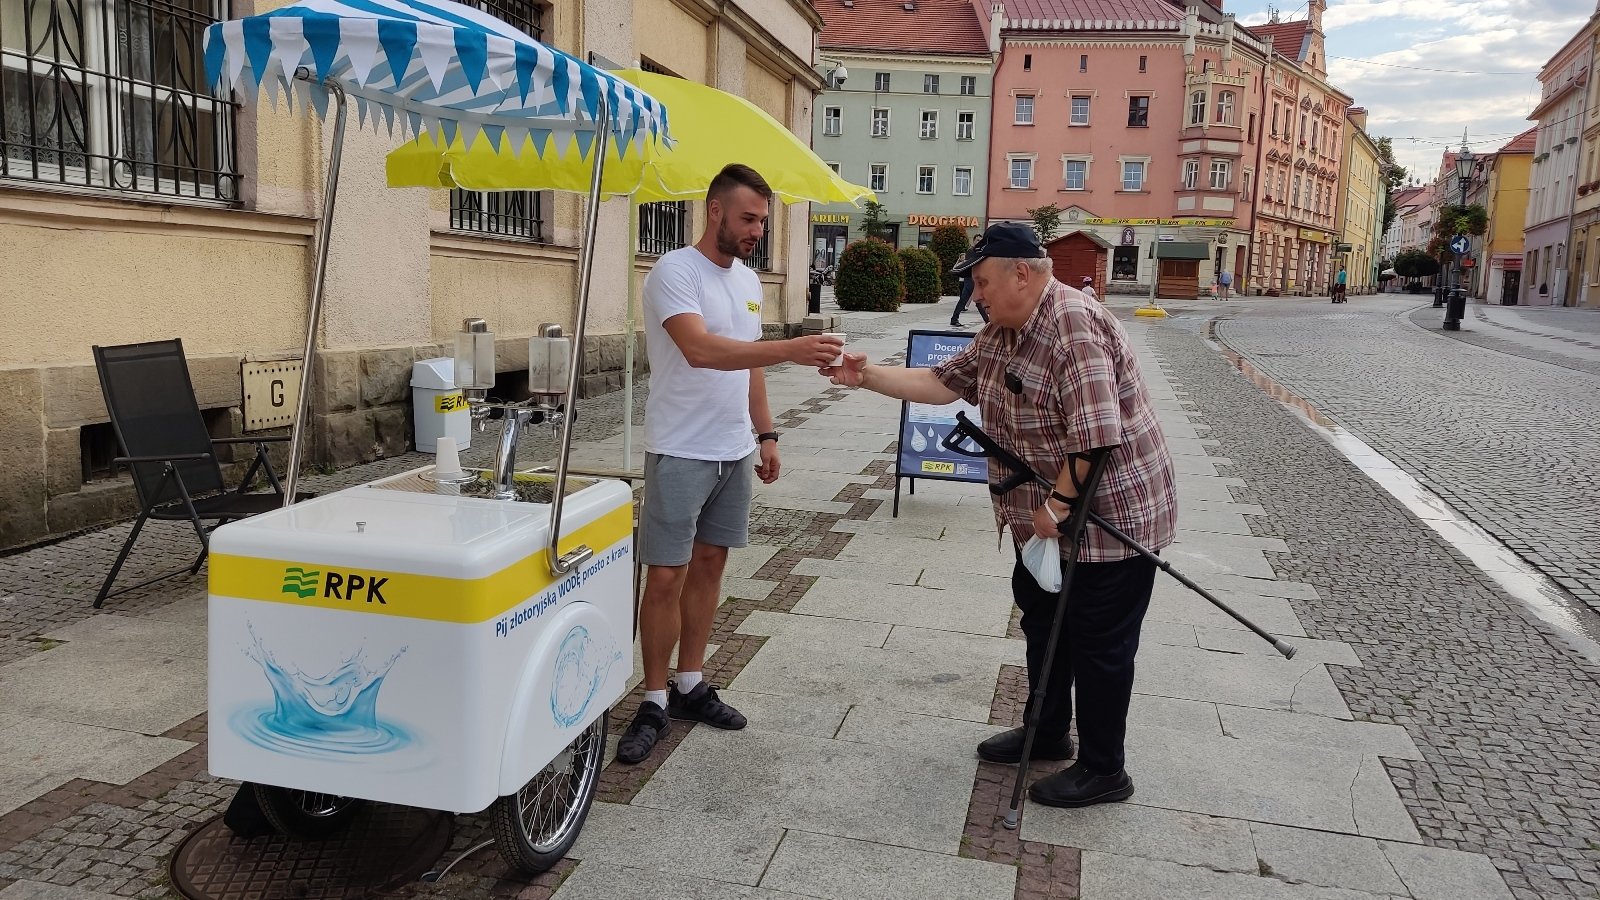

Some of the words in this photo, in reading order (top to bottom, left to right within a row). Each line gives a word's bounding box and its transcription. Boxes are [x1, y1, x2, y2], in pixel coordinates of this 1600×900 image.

[811, 214, 850, 224] ARIUM
[908, 214, 979, 227] DROGERIA
[934, 343, 963, 352] Doceń
[927, 353, 951, 362] prost
[270, 379, 285, 408] G
[935, 463, 952, 471] RPK
[323, 572, 390, 605] RPK
[496, 617, 508, 637] Pij
[510, 591, 557, 630] złotoryjską
[558, 571, 581, 598] WODĘ
[582, 559, 605, 585] prosto
[606, 557, 610, 566] z
[611, 545, 629, 563] kranu
